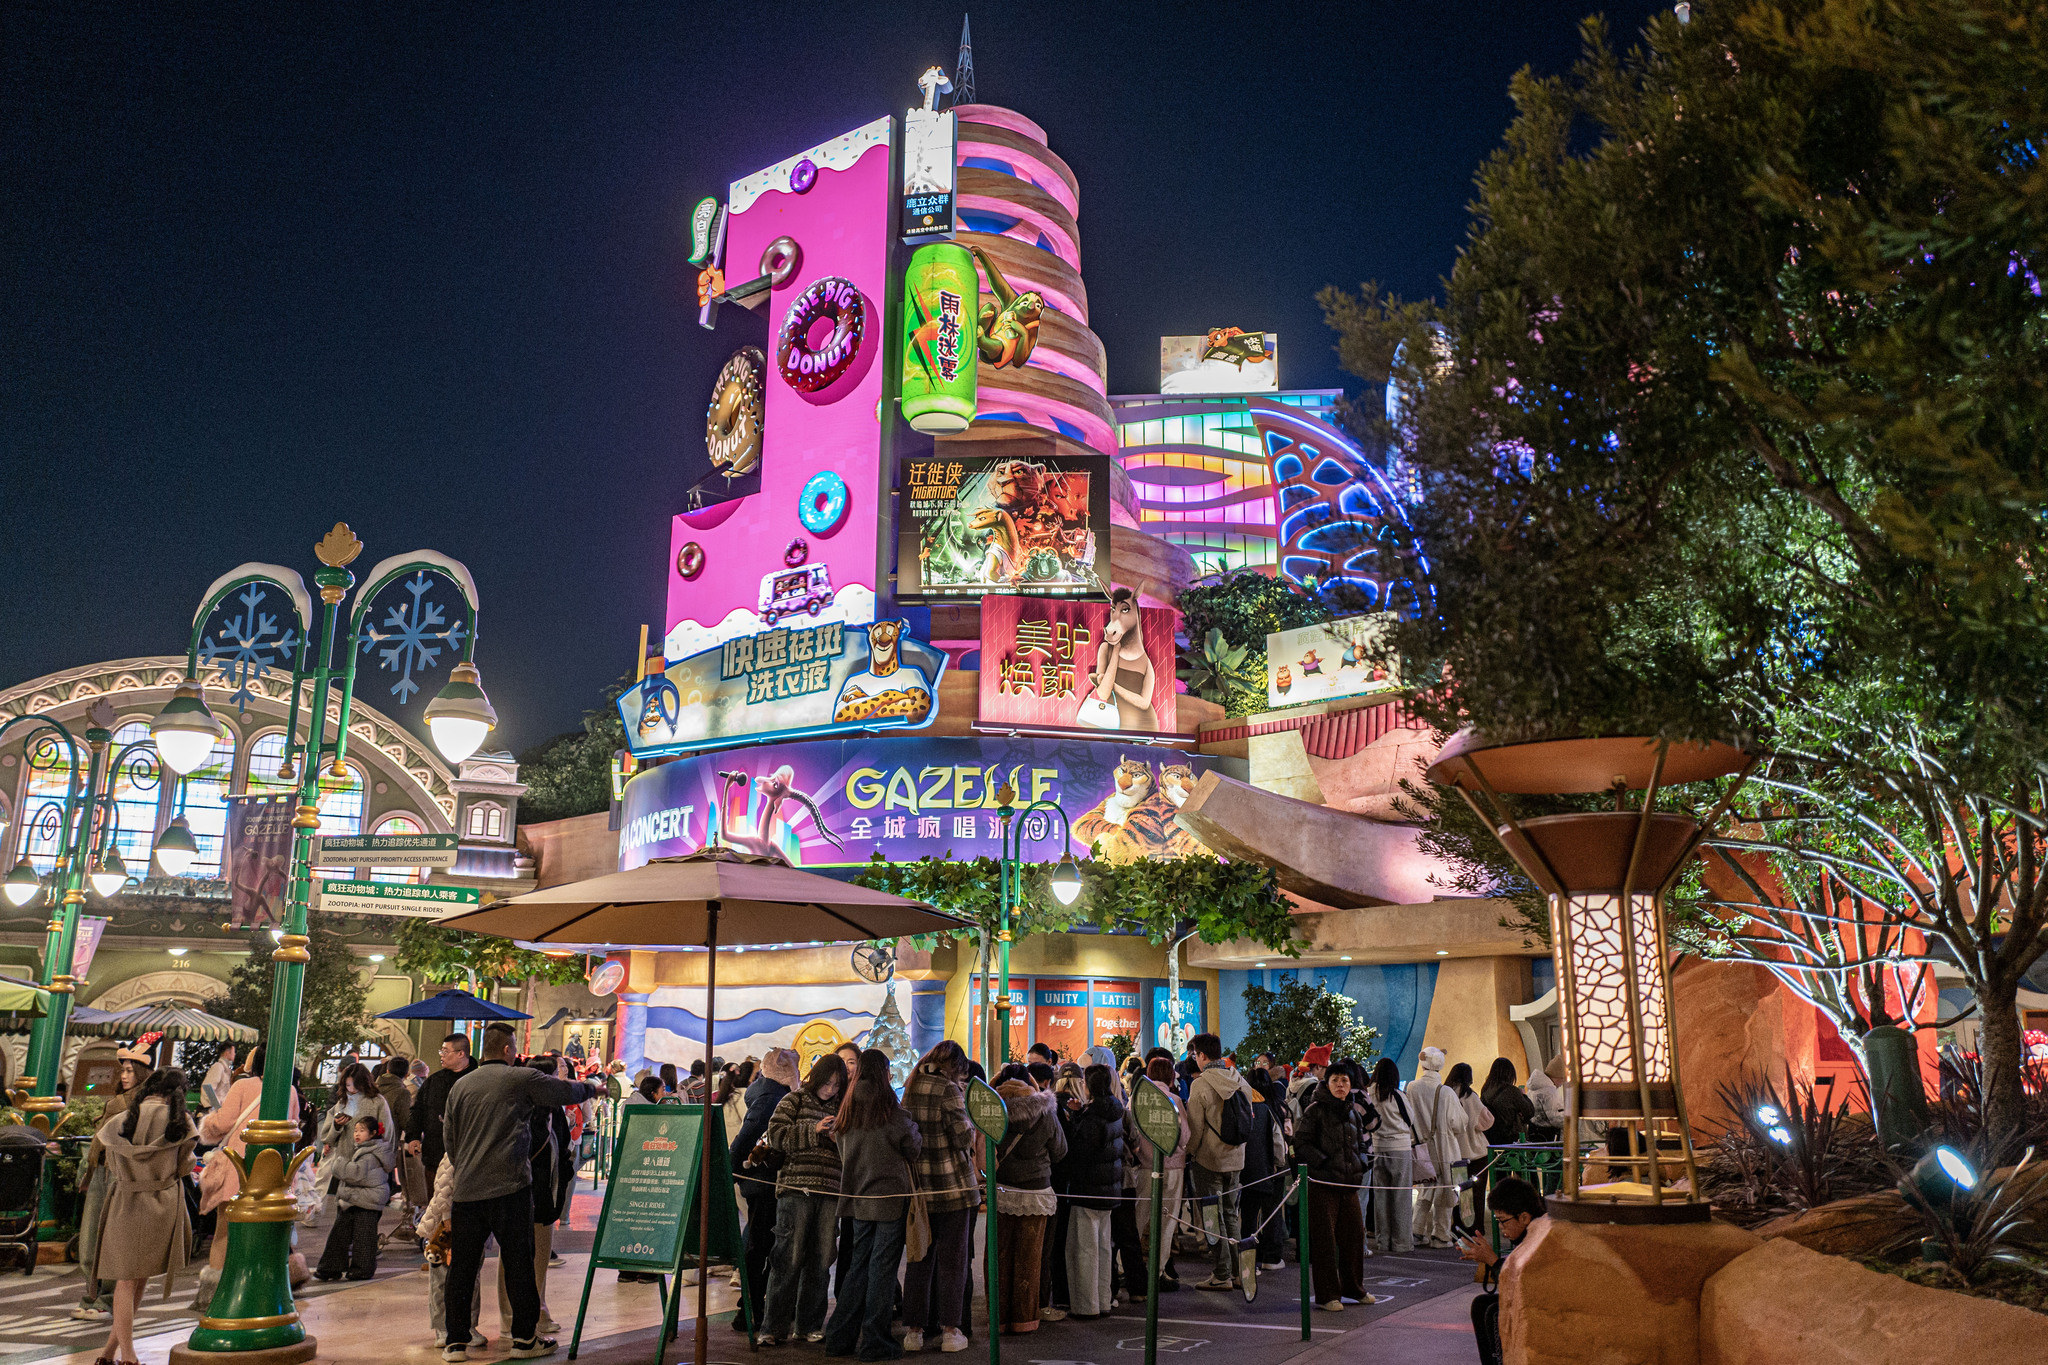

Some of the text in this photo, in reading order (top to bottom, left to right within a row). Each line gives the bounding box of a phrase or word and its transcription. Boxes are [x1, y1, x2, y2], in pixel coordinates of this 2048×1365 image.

[912, 205, 942, 216] 通信公司
[786, 281, 855, 326] THE BIG
[787, 331, 853, 374] DONUT
[712, 356, 751, 400] THE BIG
[709, 415, 747, 460] DONUT
[908, 462, 963, 485] 迁徙侠
[911, 486, 958, 499] MIGRATORS
[1016, 619, 1090, 659] 美驴
[722, 623, 842, 678] 快速祛斑
[749, 660, 828, 703] 洗衣液
[999, 659, 1076, 700] 焕颜
[846, 763, 1062, 815] GAZELLE
[244, 823, 290, 836] GAZELLE
[630, 805, 694, 850] CONCERT
[327, 900, 361, 908] ZOOTOPIA:
[401, 905, 421, 913] SINGLE
[171, 959, 190, 968] 216
[1045, 992, 1079, 1004] UNITY
[1102, 994, 1136, 1006] LATTE!
[1095, 1017, 1139, 1030] Together
[969, 1090, 991, 1102] 优先
[1136, 1092, 1162, 1106] 优先
[980, 1104, 1002, 1117] 通道
[1148, 1110, 1174, 1125] 通道
[643, 1156, 671, 1167] 单人通道
[649, 1201, 665, 1209] RIDER
